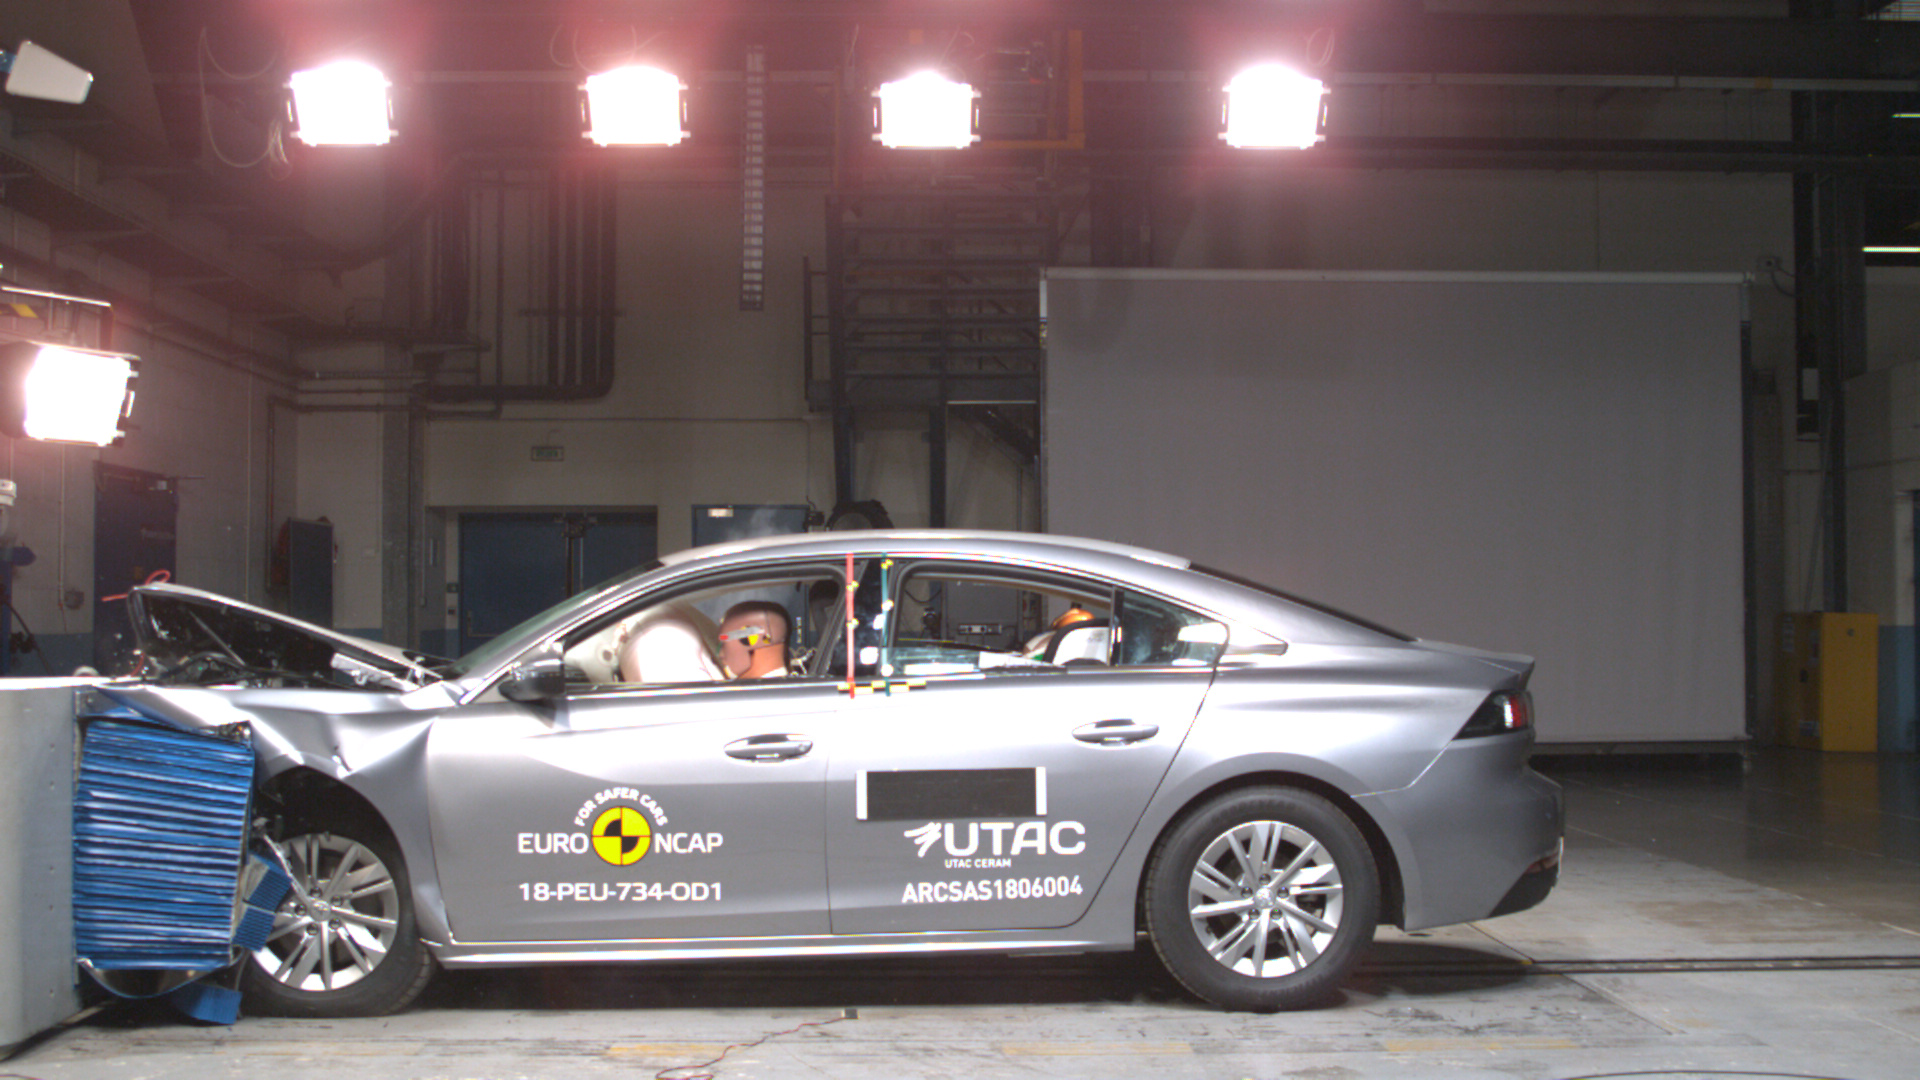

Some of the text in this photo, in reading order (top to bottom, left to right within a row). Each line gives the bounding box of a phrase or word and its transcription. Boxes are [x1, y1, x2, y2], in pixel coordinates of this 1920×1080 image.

[574, 787, 668, 826] FOR SAFER CARS
[518, 833, 724, 854] EURO NCAP
[944, 821, 1086, 856] UTAC
[944, 858, 1012, 869] UTAC CERAM
[519, 882, 721, 901] 18-PEU-734-OD1
[902, 875, 1083, 903] ARCSAS1806004
